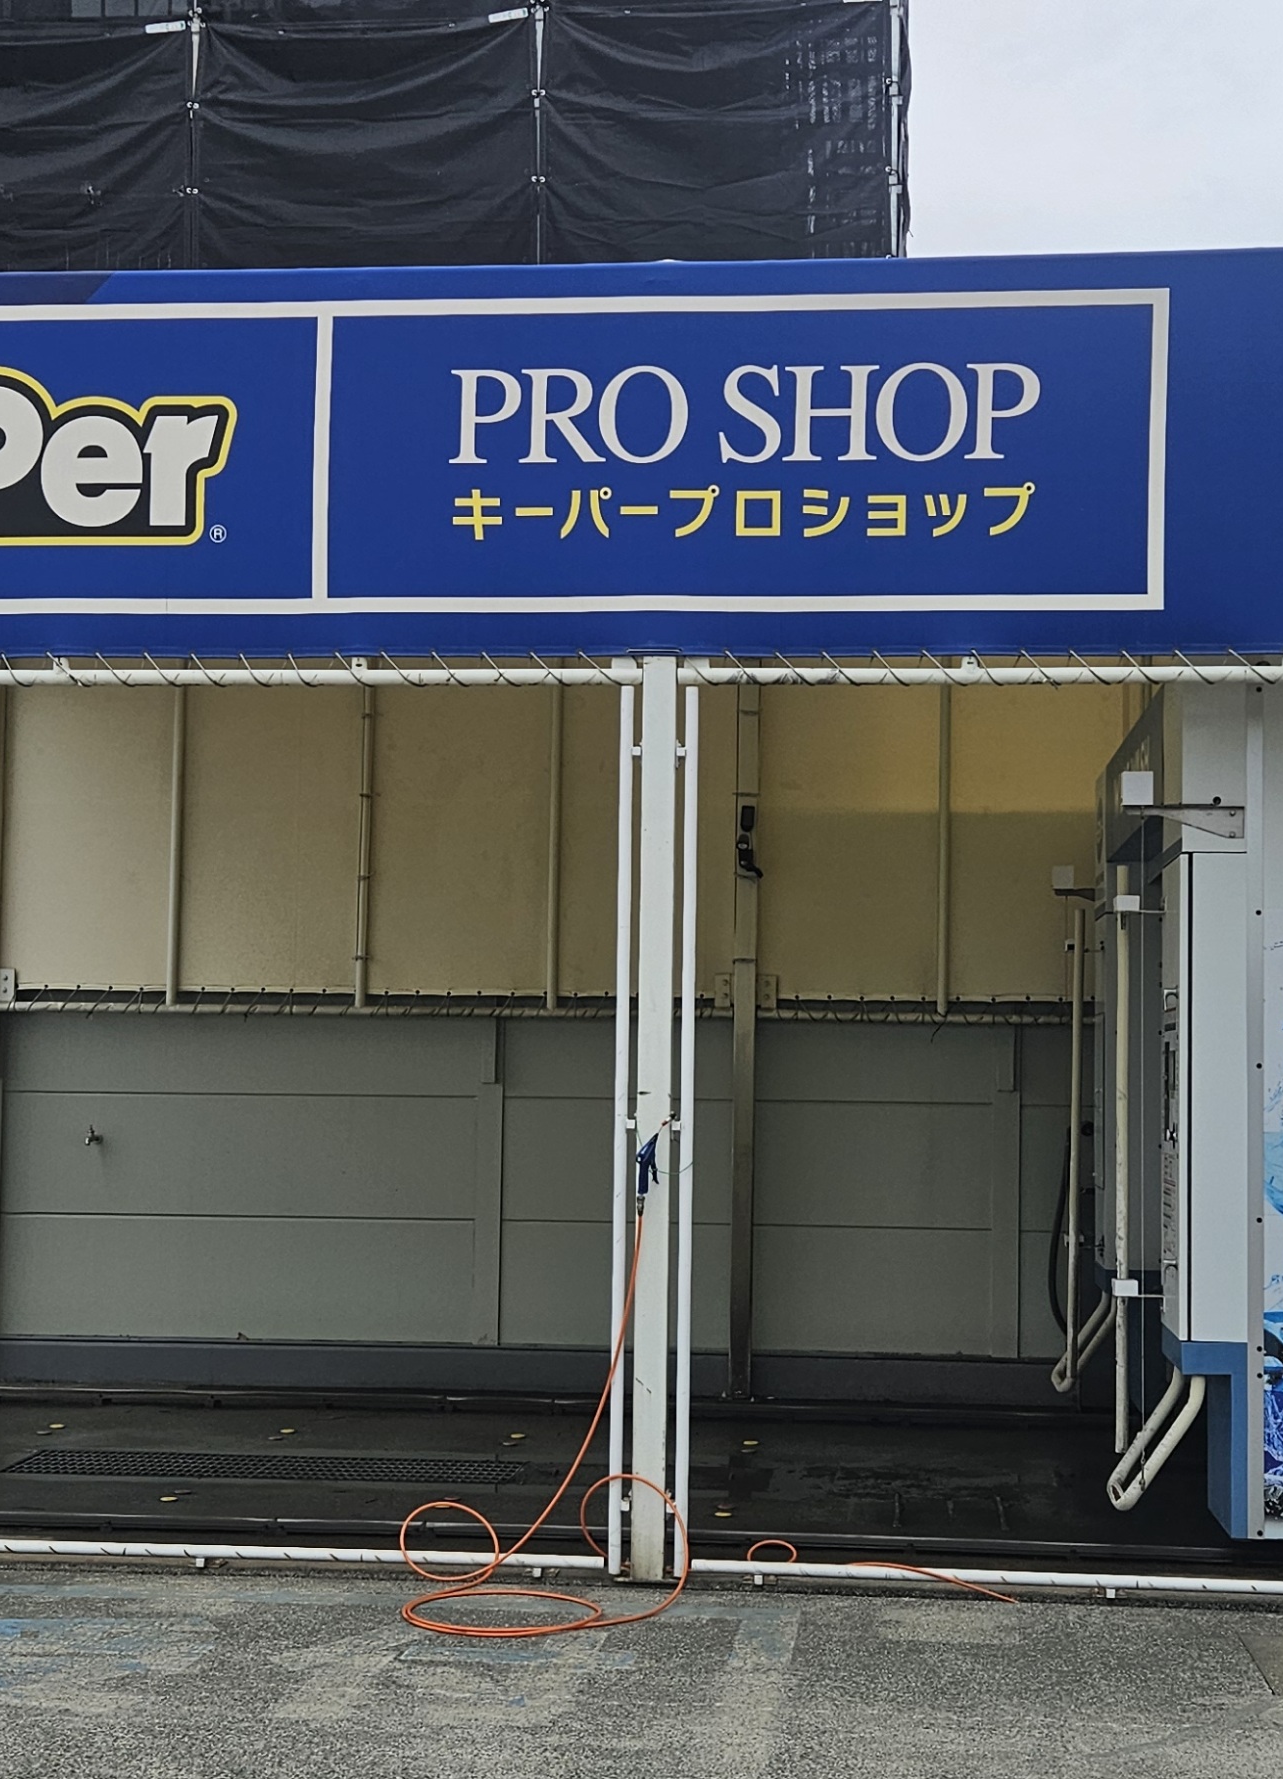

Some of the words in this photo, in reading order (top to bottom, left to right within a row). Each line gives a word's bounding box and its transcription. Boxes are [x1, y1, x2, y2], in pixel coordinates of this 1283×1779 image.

[449, 366, 689, 465] PRO
[719, 362, 1041, 463] SHOP
[452, 481, 1036, 540] キーパープロショップ
